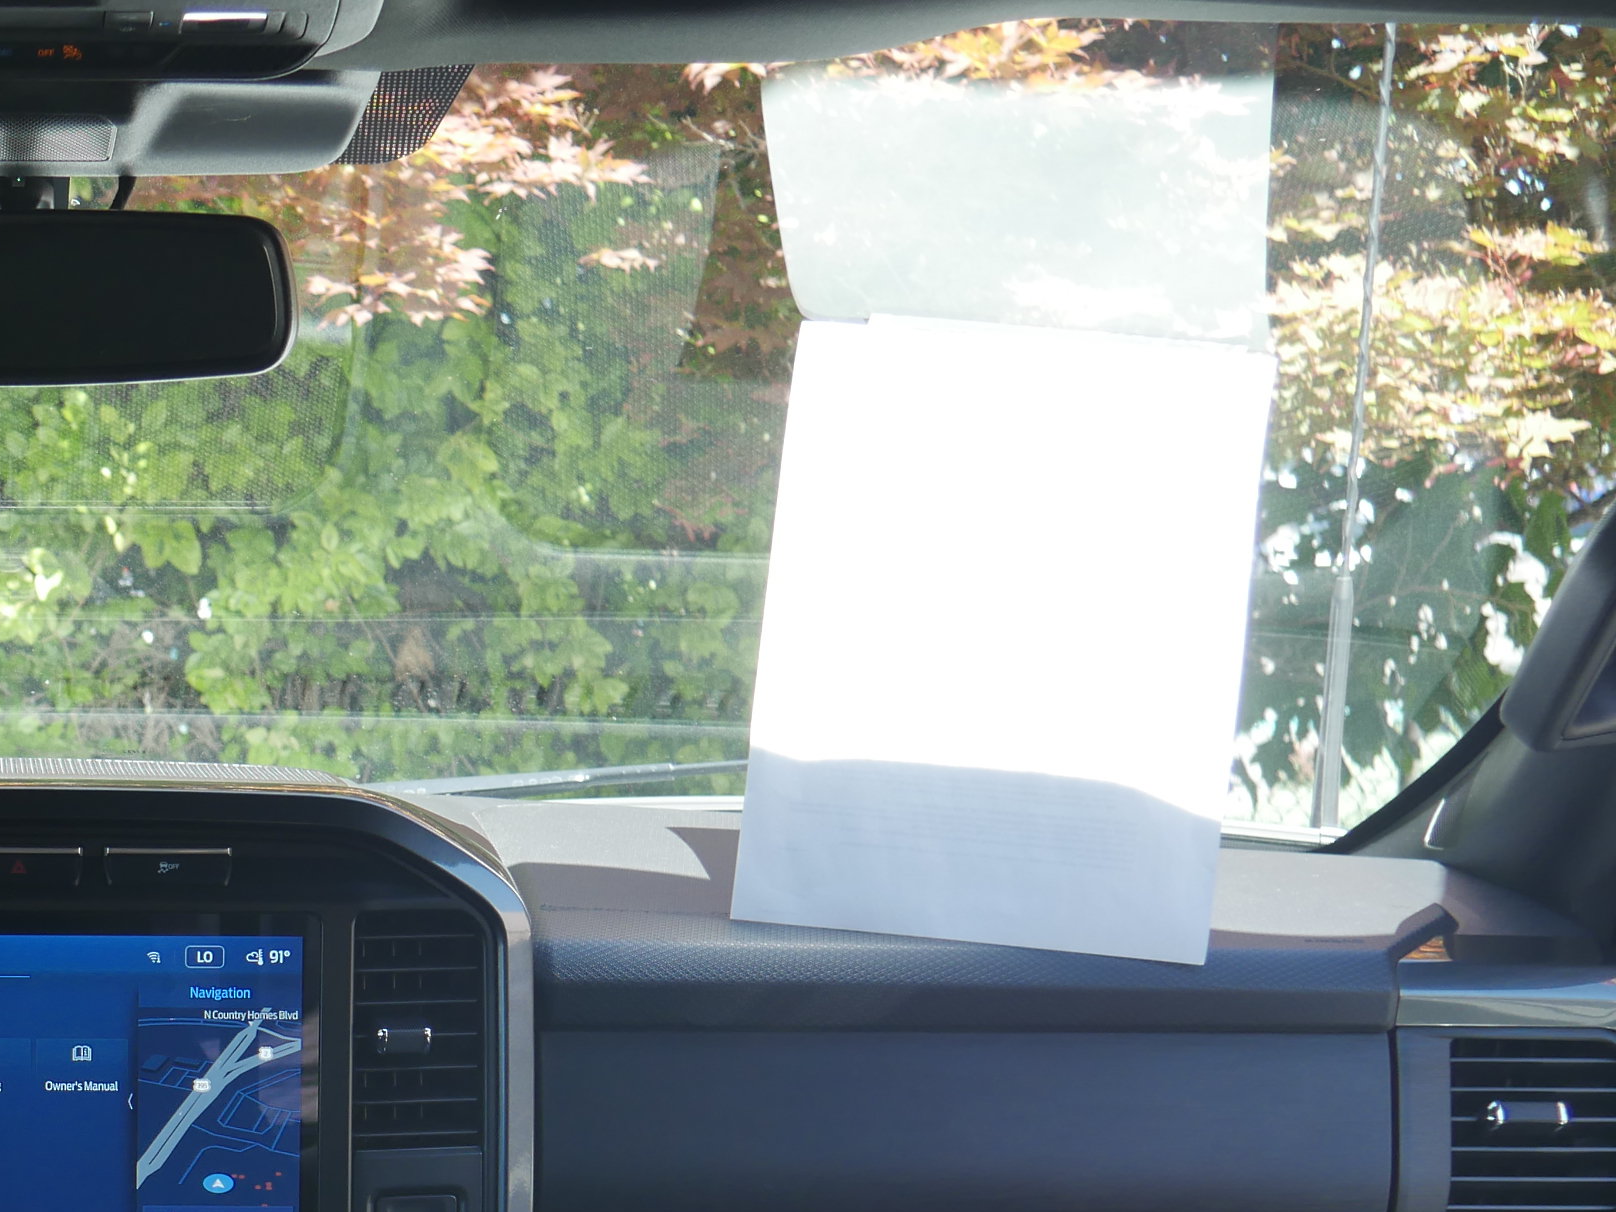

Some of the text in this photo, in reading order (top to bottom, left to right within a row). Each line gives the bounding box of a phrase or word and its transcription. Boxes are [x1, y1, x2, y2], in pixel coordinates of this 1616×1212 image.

[196, 950, 214, 964] LO
[189, 986, 251, 1001] Navigation
[204, 1010, 299, 1022] N Country Homes Blvd
[44, 1080, 119, 1092] Owner's Manual
